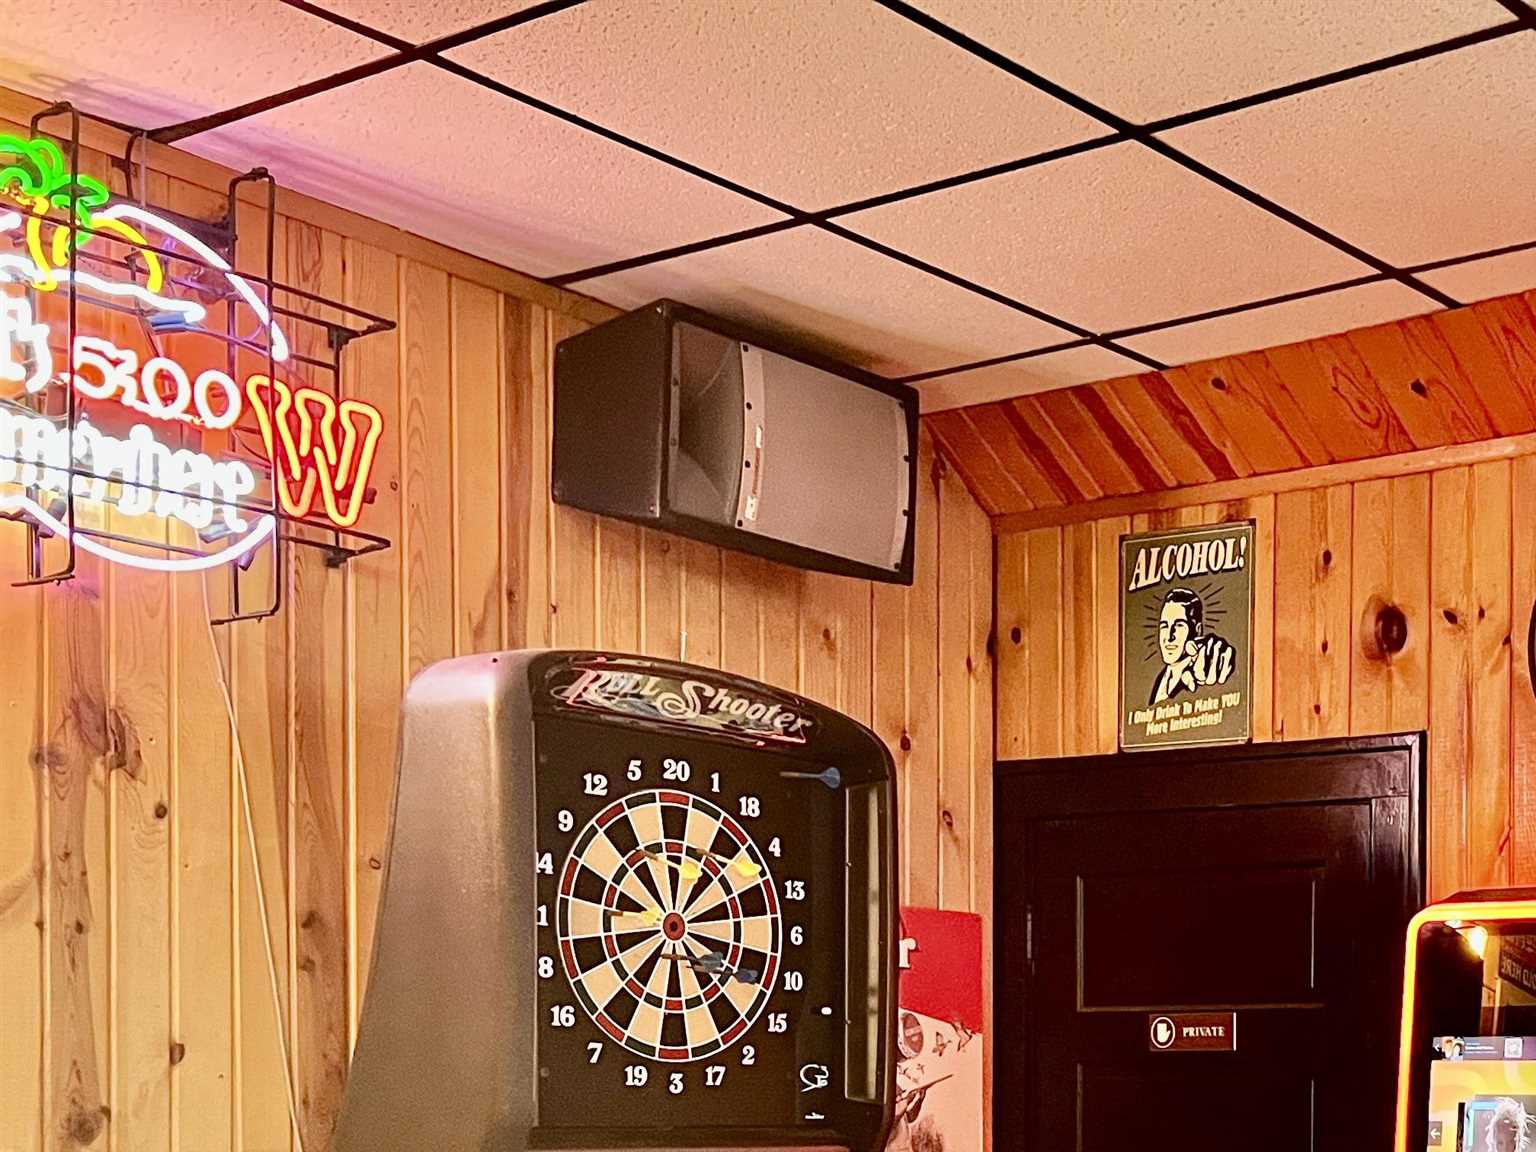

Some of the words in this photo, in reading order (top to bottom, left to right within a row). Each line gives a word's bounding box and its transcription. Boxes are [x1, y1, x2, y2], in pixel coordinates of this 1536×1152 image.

[1128, 537, 1247, 591] ALCOHOL!
[1134, 709, 1154, 724] Only
[1156, 703, 1181, 721] Drink
[1194, 697, 1219, 713] Make
[1222, 692, 1241, 709] YOU
[1146, 721, 1168, 737] More
[627, 760, 641, 780] 5
[663, 759, 690, 781] 20
[584, 773, 607, 795] 12
[711, 773, 719, 792] 1
[739, 796, 760, 817] 18
[559, 810, 573, 831] 9
[769, 838, 780, 857] 4
[785, 880, 805, 900] 13
[791, 926, 802, 945] 6
[539, 957, 553, 978] 8
[784, 972, 802, 991] 10
[551, 1006, 575, 1026] 16
[768, 1013, 787, 1032] 15
[1183, 1026, 1225, 1038] PRIVATE
[587, 1042, 602, 1063] 7
[742, 1046, 754, 1064] 2
[625, 1066, 647, 1086] 19
[669, 1073, 683, 1093] 3
[706, 1066, 725, 1085] 17
